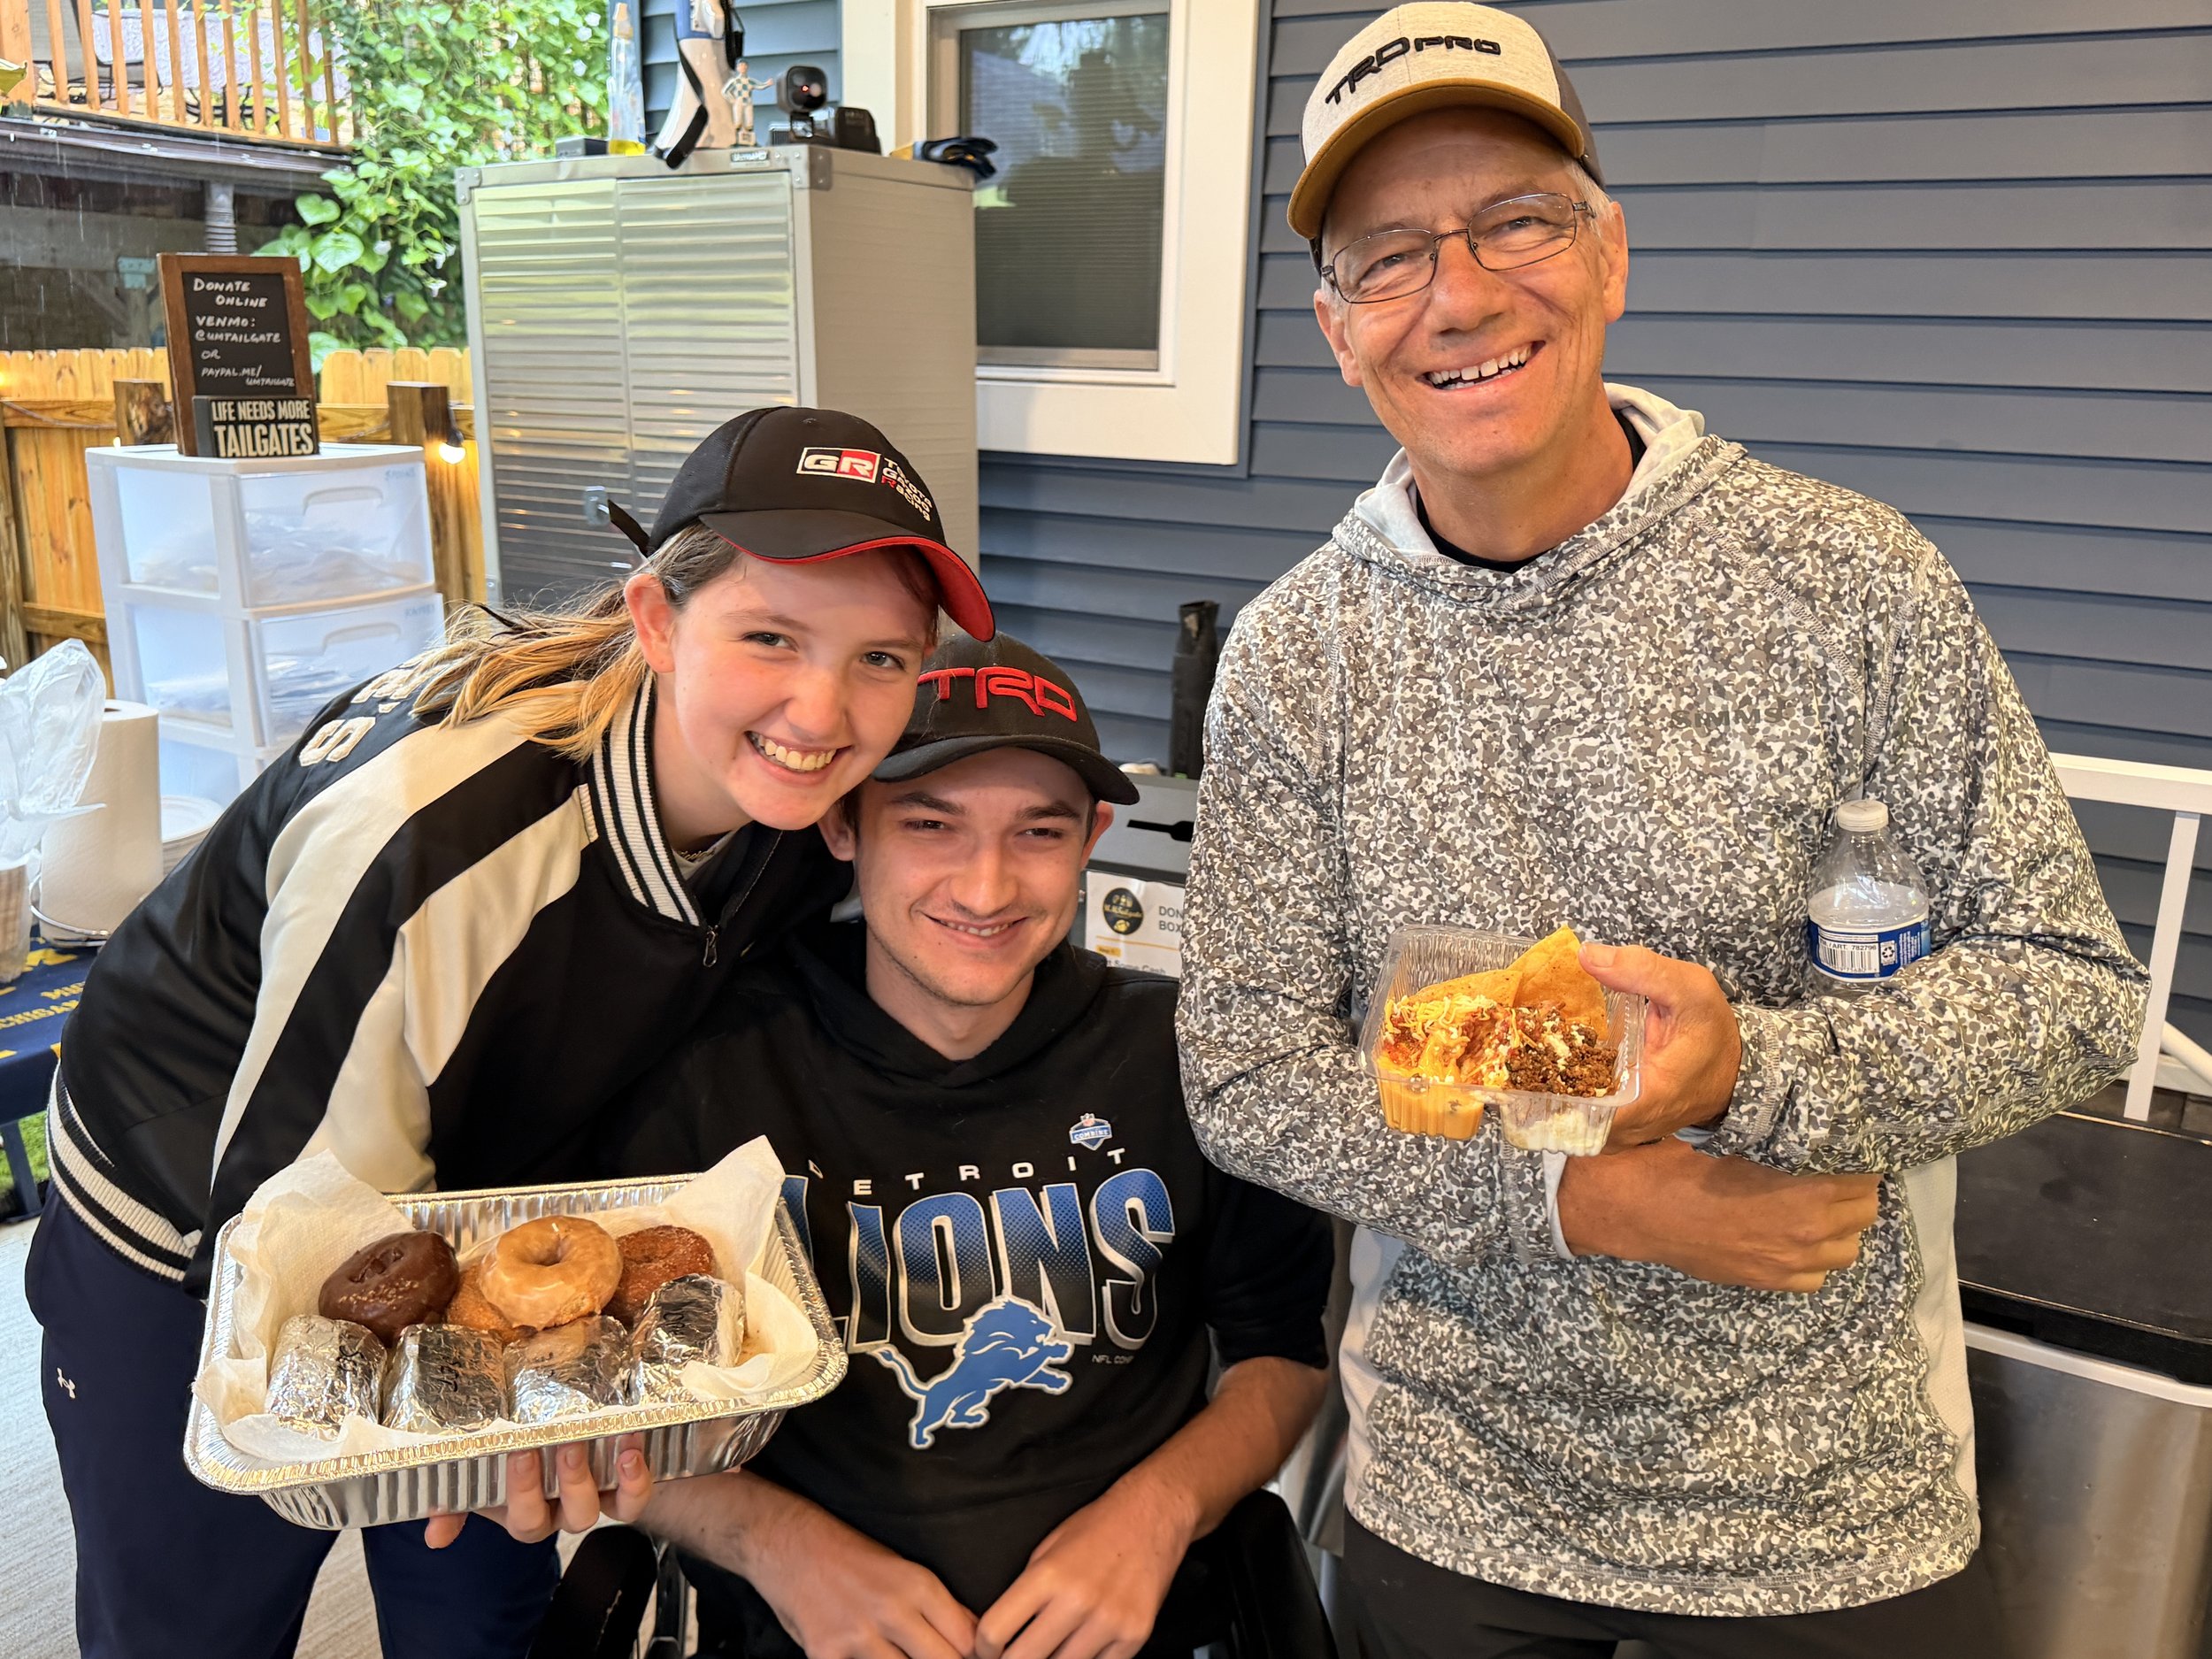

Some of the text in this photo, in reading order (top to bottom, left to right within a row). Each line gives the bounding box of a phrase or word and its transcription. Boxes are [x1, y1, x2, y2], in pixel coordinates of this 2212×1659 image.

[1325, 35, 1501, 104] TRD PRO
[193, 278, 250, 292] DONATE
[215, 295, 268, 308] ONLINE
[196, 316, 256, 327] VENMO:
[201, 349, 221, 359] OR
[211, 399, 311, 421] LIFE NEEDS MORE
[214, 423, 314, 457] TAILGATES
[803, 454, 874, 478] GR
[917, 666, 1078, 722] TRD
